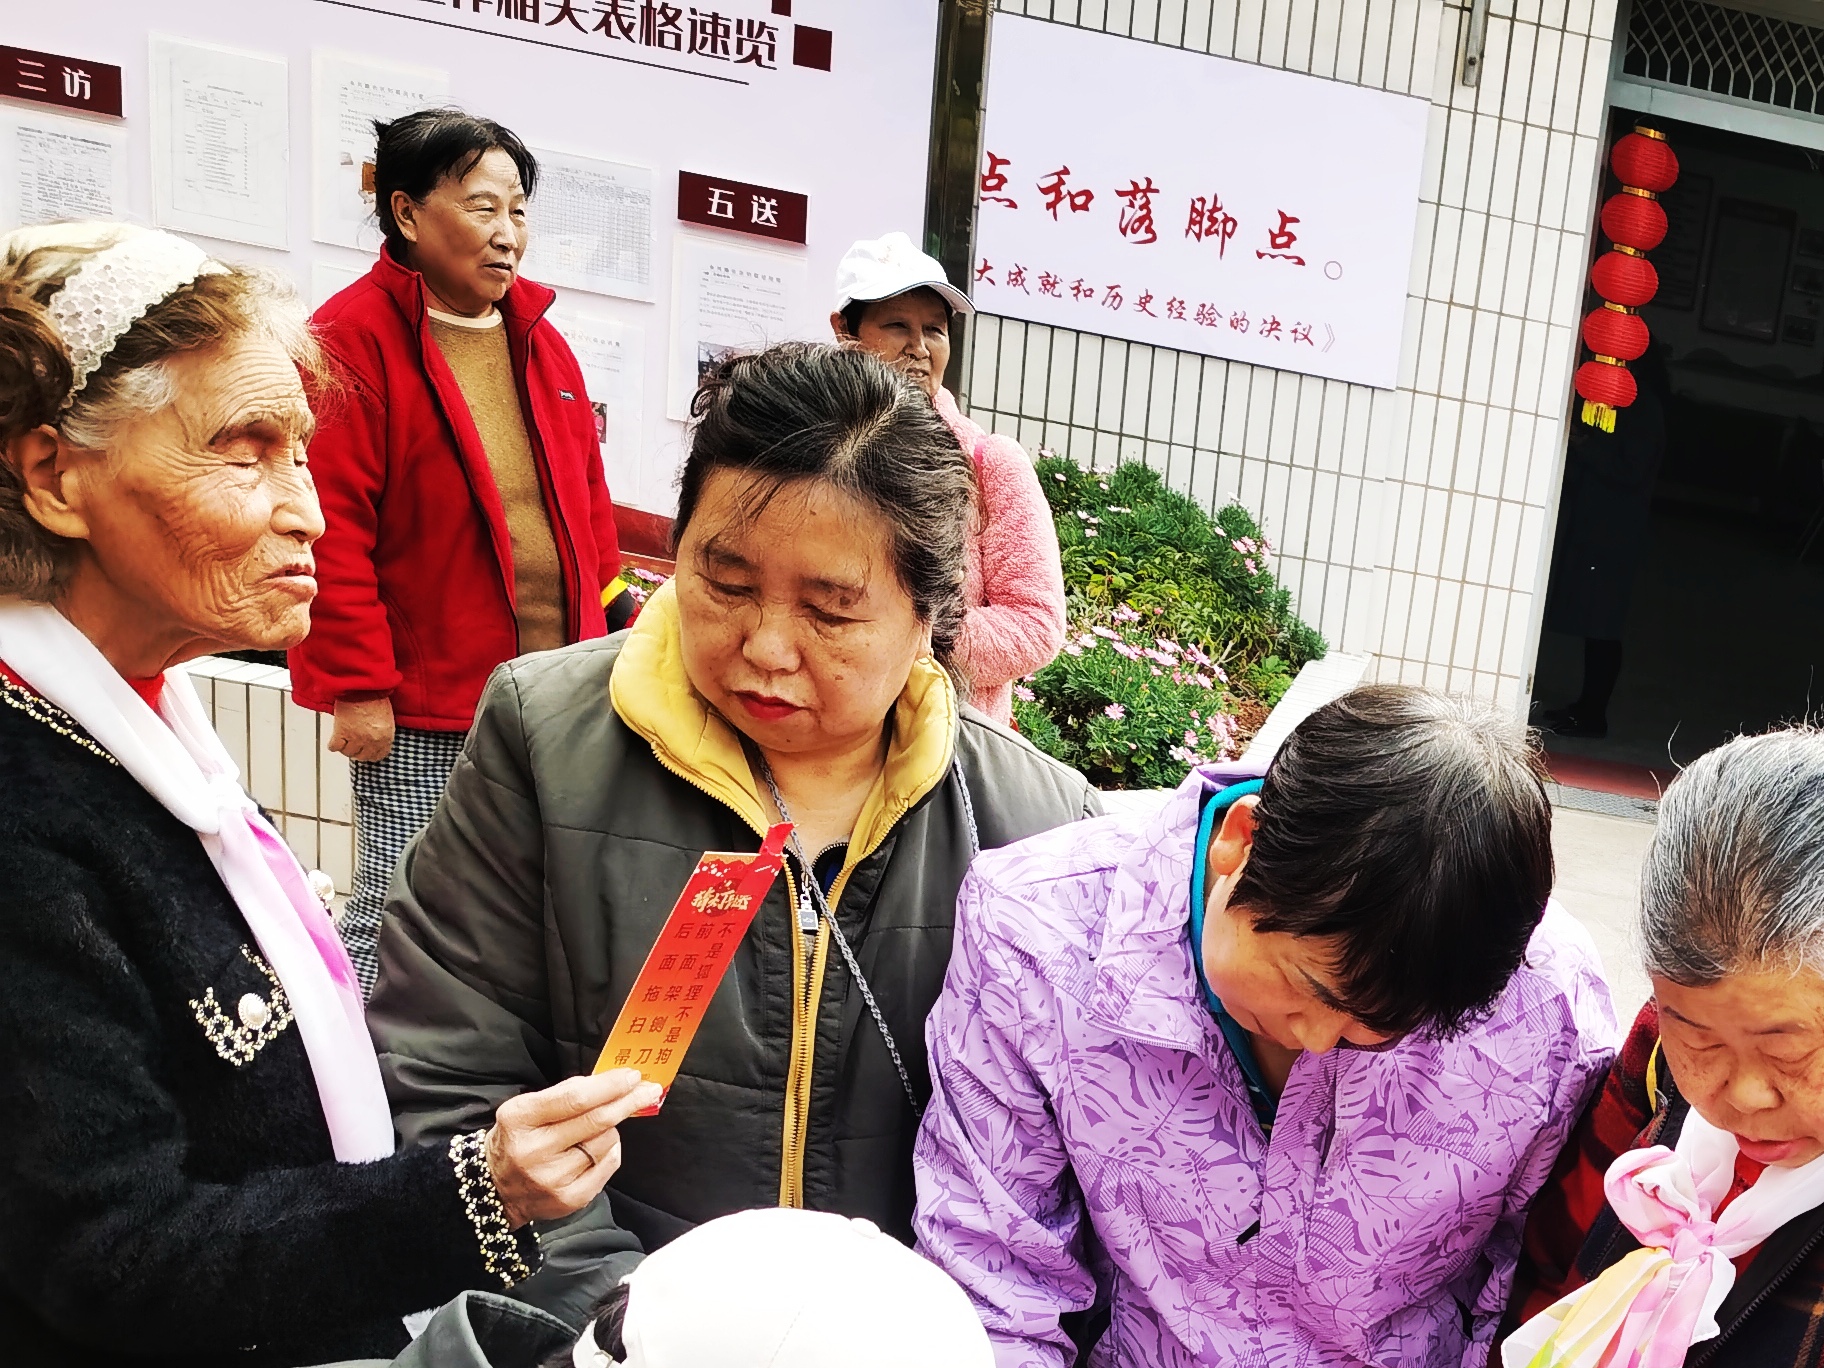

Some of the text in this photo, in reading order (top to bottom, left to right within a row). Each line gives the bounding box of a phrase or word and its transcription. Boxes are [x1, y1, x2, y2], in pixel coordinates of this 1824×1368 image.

[419, 0, 777, 70] 相关表格速览
[16, 58, 92, 100] 三访
[707, 187, 778, 228] 五送
[974, 258, 1336, 353] 大成就和历史经验的决议》
[657, 922, 736, 1065] 不是狐狸不是狗
